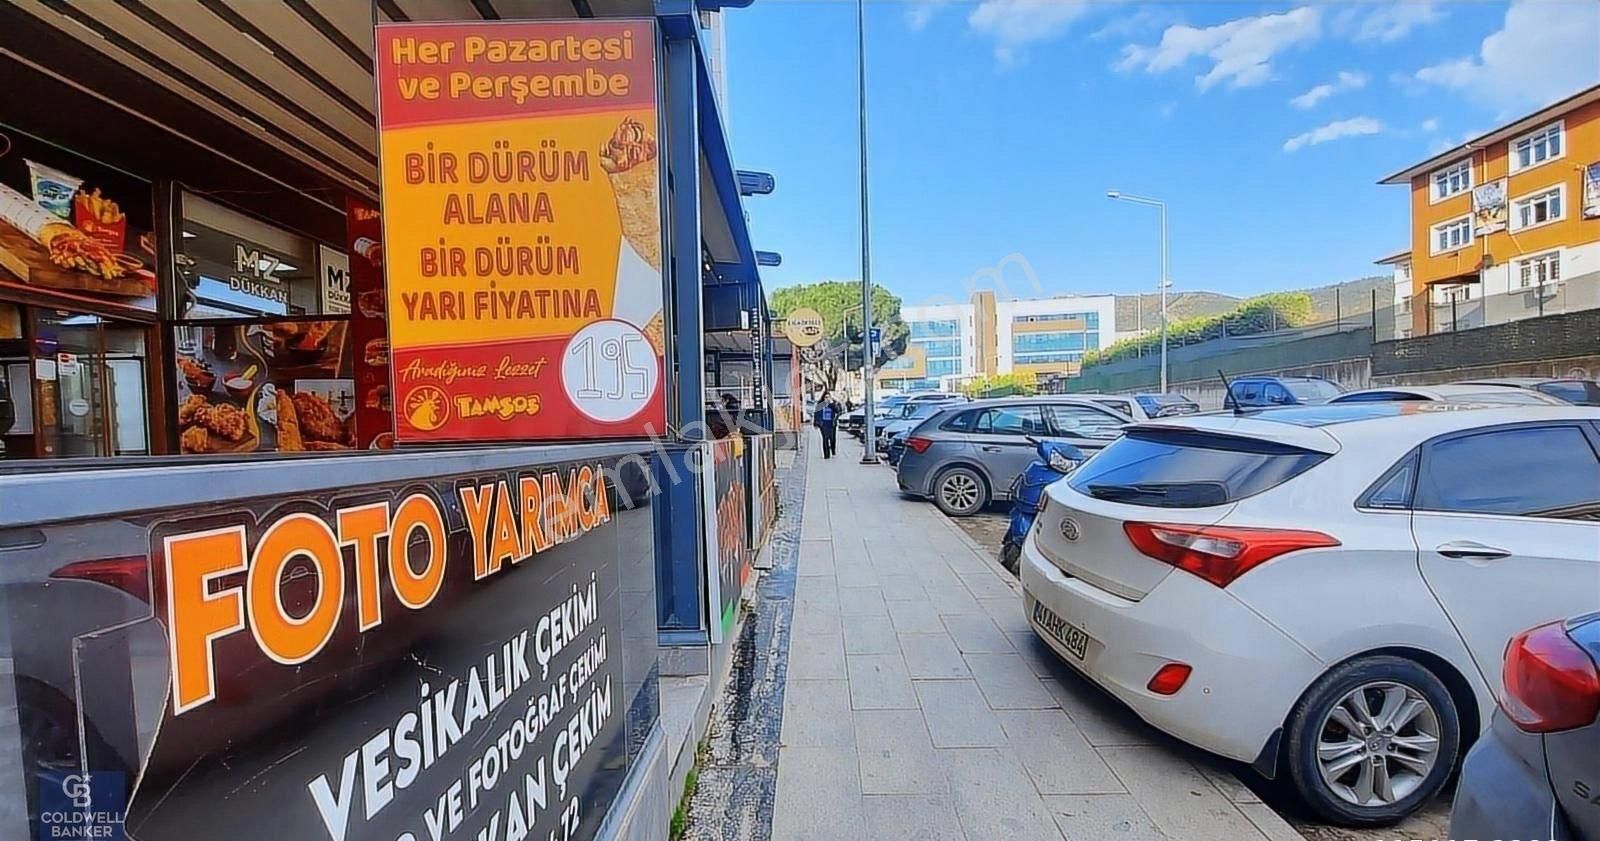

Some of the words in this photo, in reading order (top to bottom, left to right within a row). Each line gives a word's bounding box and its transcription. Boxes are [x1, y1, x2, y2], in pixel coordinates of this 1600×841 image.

[392, 37, 455, 65] Her
[464, 30, 634, 63] Pazartesi
[399, 76, 440, 100] ve
[449, 68, 630, 105] Perşembe
[405, 142, 458, 184] BİR
[468, 140, 590, 183] DÜRÜM
[443, 192, 554, 225] ALANA
[235, 244, 280, 283] MZ
[420, 237, 467, 277] BİR
[475, 237, 579, 276] DÜRÜM
[229, 275, 289, 303] DÜKKAN
[402, 291, 465, 320] YARI
[474, 281, 602, 320] FİYATINA
[494, 355, 548, 380] Lezzet
[572, 333, 649, 400] 195
[164, 494, 447, 716] FOTO
[459, 463, 611, 581] YARIMCA
[308, 628, 530, 841] VESİKALIK
[535, 571, 599, 680] ÇEKİMİ
[424, 779, 464, 841] VE
[468, 674, 567, 809] FOTOĞRAF
[569, 626, 607, 704] ÇEKİMİ
[552, 674, 612, 800] ÇEKİM
